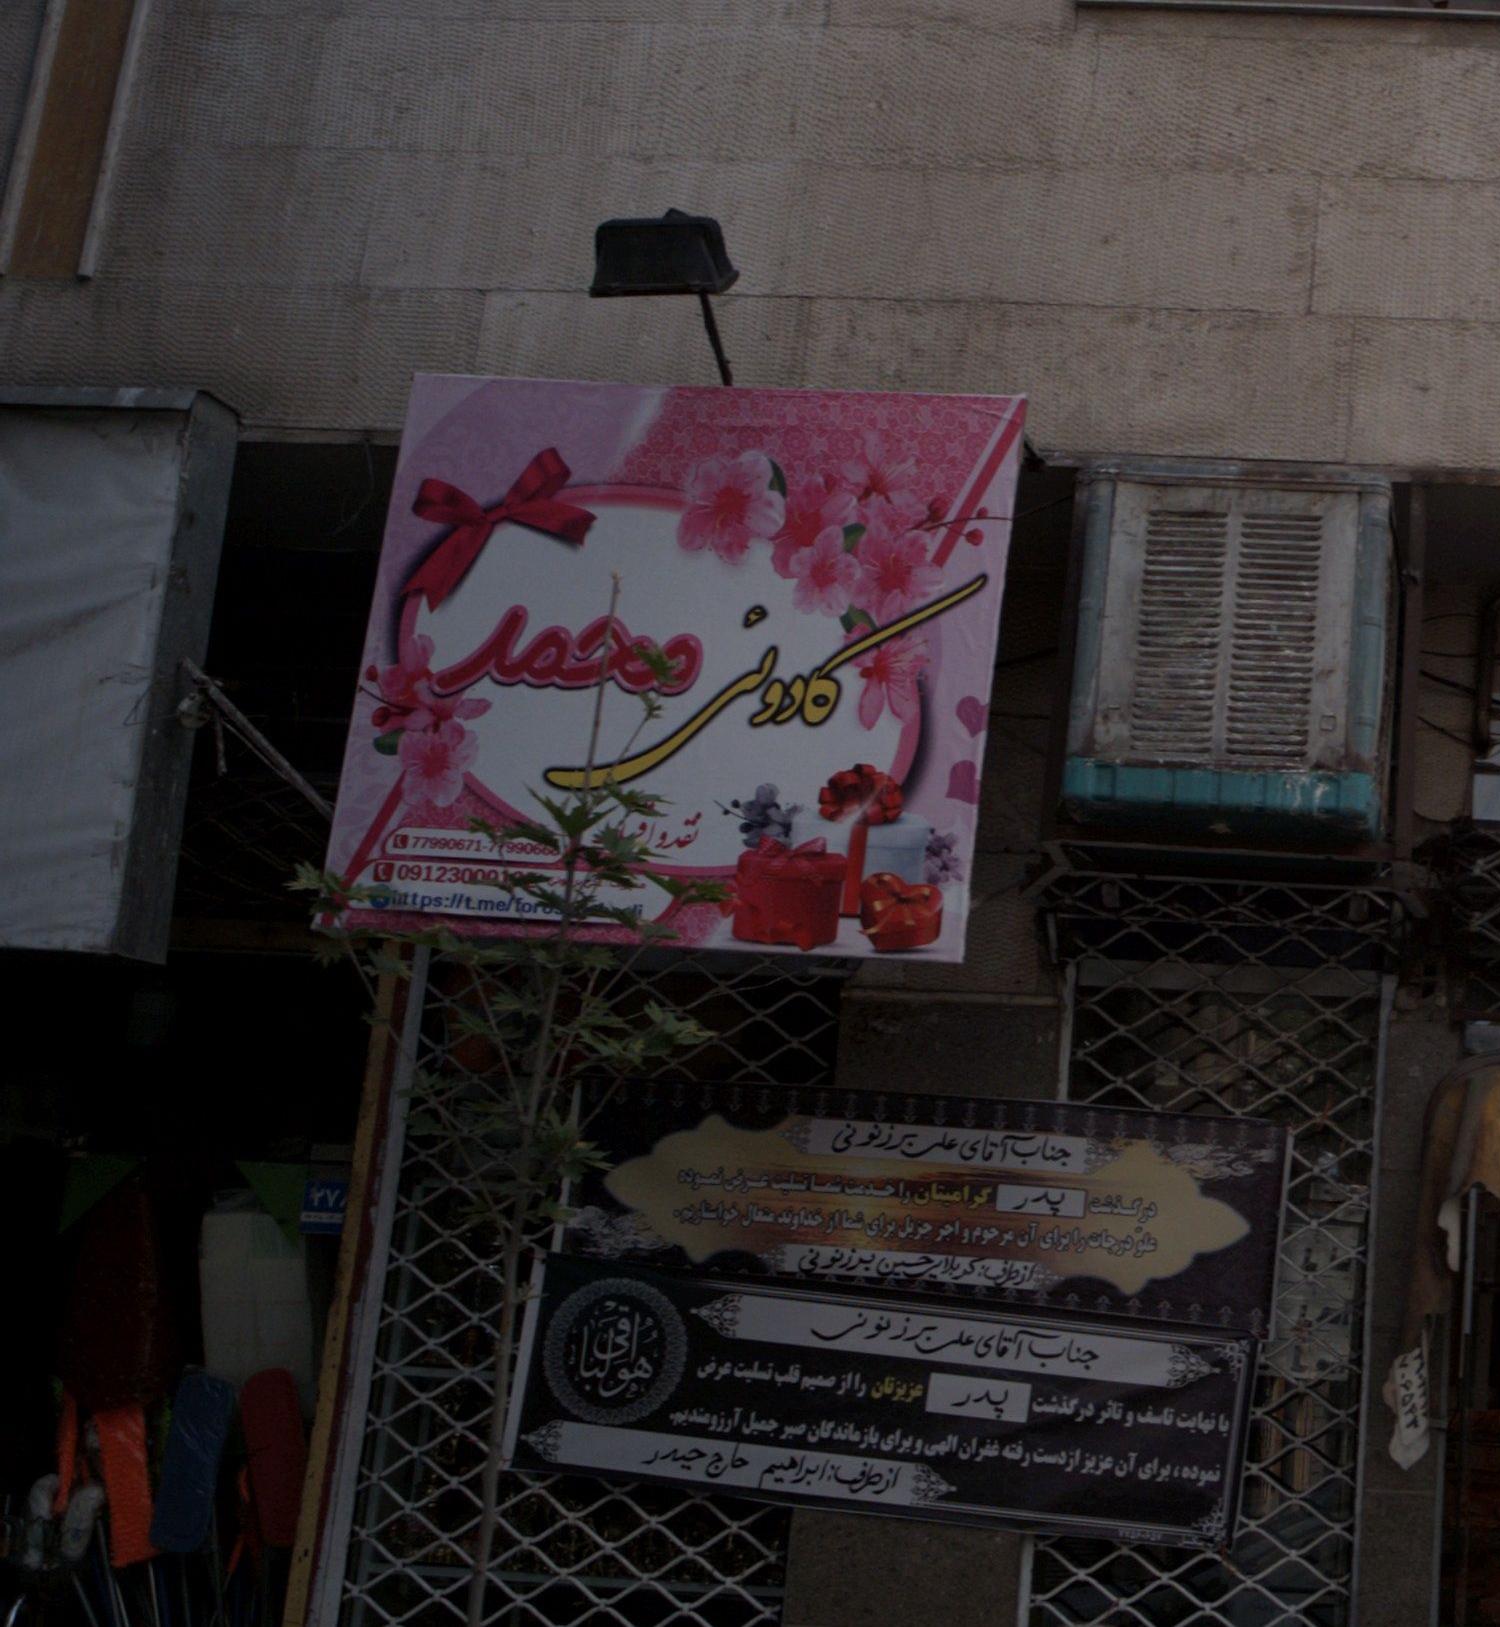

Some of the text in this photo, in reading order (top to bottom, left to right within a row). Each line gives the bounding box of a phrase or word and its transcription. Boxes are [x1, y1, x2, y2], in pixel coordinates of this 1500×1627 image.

[429, 604, 702, 697] محمد
[901, 1131, 958, 1158] علی
[958, 1133, 1036, 1162] آقای
[1011, 1135, 1072, 1166] جناب
[676, 1166, 724, 1192] نموده
[723, 1168, 769, 1194] عرض
[769, 1171, 810, 1197] تسلیت
[811, 1173, 843, 1195] شما
[843, 1178, 896, 1200] خدمت
[897, 1181, 911, 1206] را
[914, 1180, 994, 1210] گرامیتان
[1012, 1189, 1067, 1216] پدر
[742, 1203, 776, 1228] متعال
[777, 1205, 824, 1232] خداوند
[825, 1209, 843, 1235] از
[841, 1208, 866, 1232] شما
[864, 1211, 897, 1240] برای
[898, 1213, 933, 1242] جزیل
[935, 1219, 961, 1244] اجر
[972, 1224, 1015, 1248] مرحوم
[1017, 1221, 1038, 1248] آن
[1039, 1225, 1071, 1252] برای
[1072, 1226, 1087, 1253] را
[1088, 1229, 1135, 1257] درجات
[877, 1253, 935, 1276] حسین
[914, 1330, 975, 1355] علی
[975, 1328, 1060, 1360] آقای
[1028, 1339, 1099, 1370] جناب
[696, 1356, 734, 1382] عرض
[734, 1360, 775, 1384] تسلیت
[773, 1363, 801, 1388] قلب
[800, 1371, 837, 1390] صمیم
[836, 1371, 853, 1395] از
[852, 1372, 868, 1398] را
[869, 1375, 926, 1401] عزیزتان
[951, 1388, 1010, 1419] پدر
[1096, 1399, 1123, 1425] تاثر
[742, 1409, 779, 1435] جمیل
[778, 1420, 807, 1441] صبر
[1136, 1405, 1176, 1430] تاسف
[1176, 1410, 1216, 1435] نهایت
[1217, 1411, 1231, 1437] با
[879, 1427, 914, 1453] برای
[924, 1432, 959, 1456] الهی
[958, 1436, 1001, 1461] غفران
[641, 1447, 707, 1471] حیدر
[705, 1441, 750, 1479] حاج
[1001, 1441, 1031, 1468] رفته
[1080, 1453, 1114, 1476] عزیز
[1114, 1451, 1136, 1479] آن
[759, 1455, 831, 1491] ابراهیم
[1137, 1456, 1172, 1483] برای
